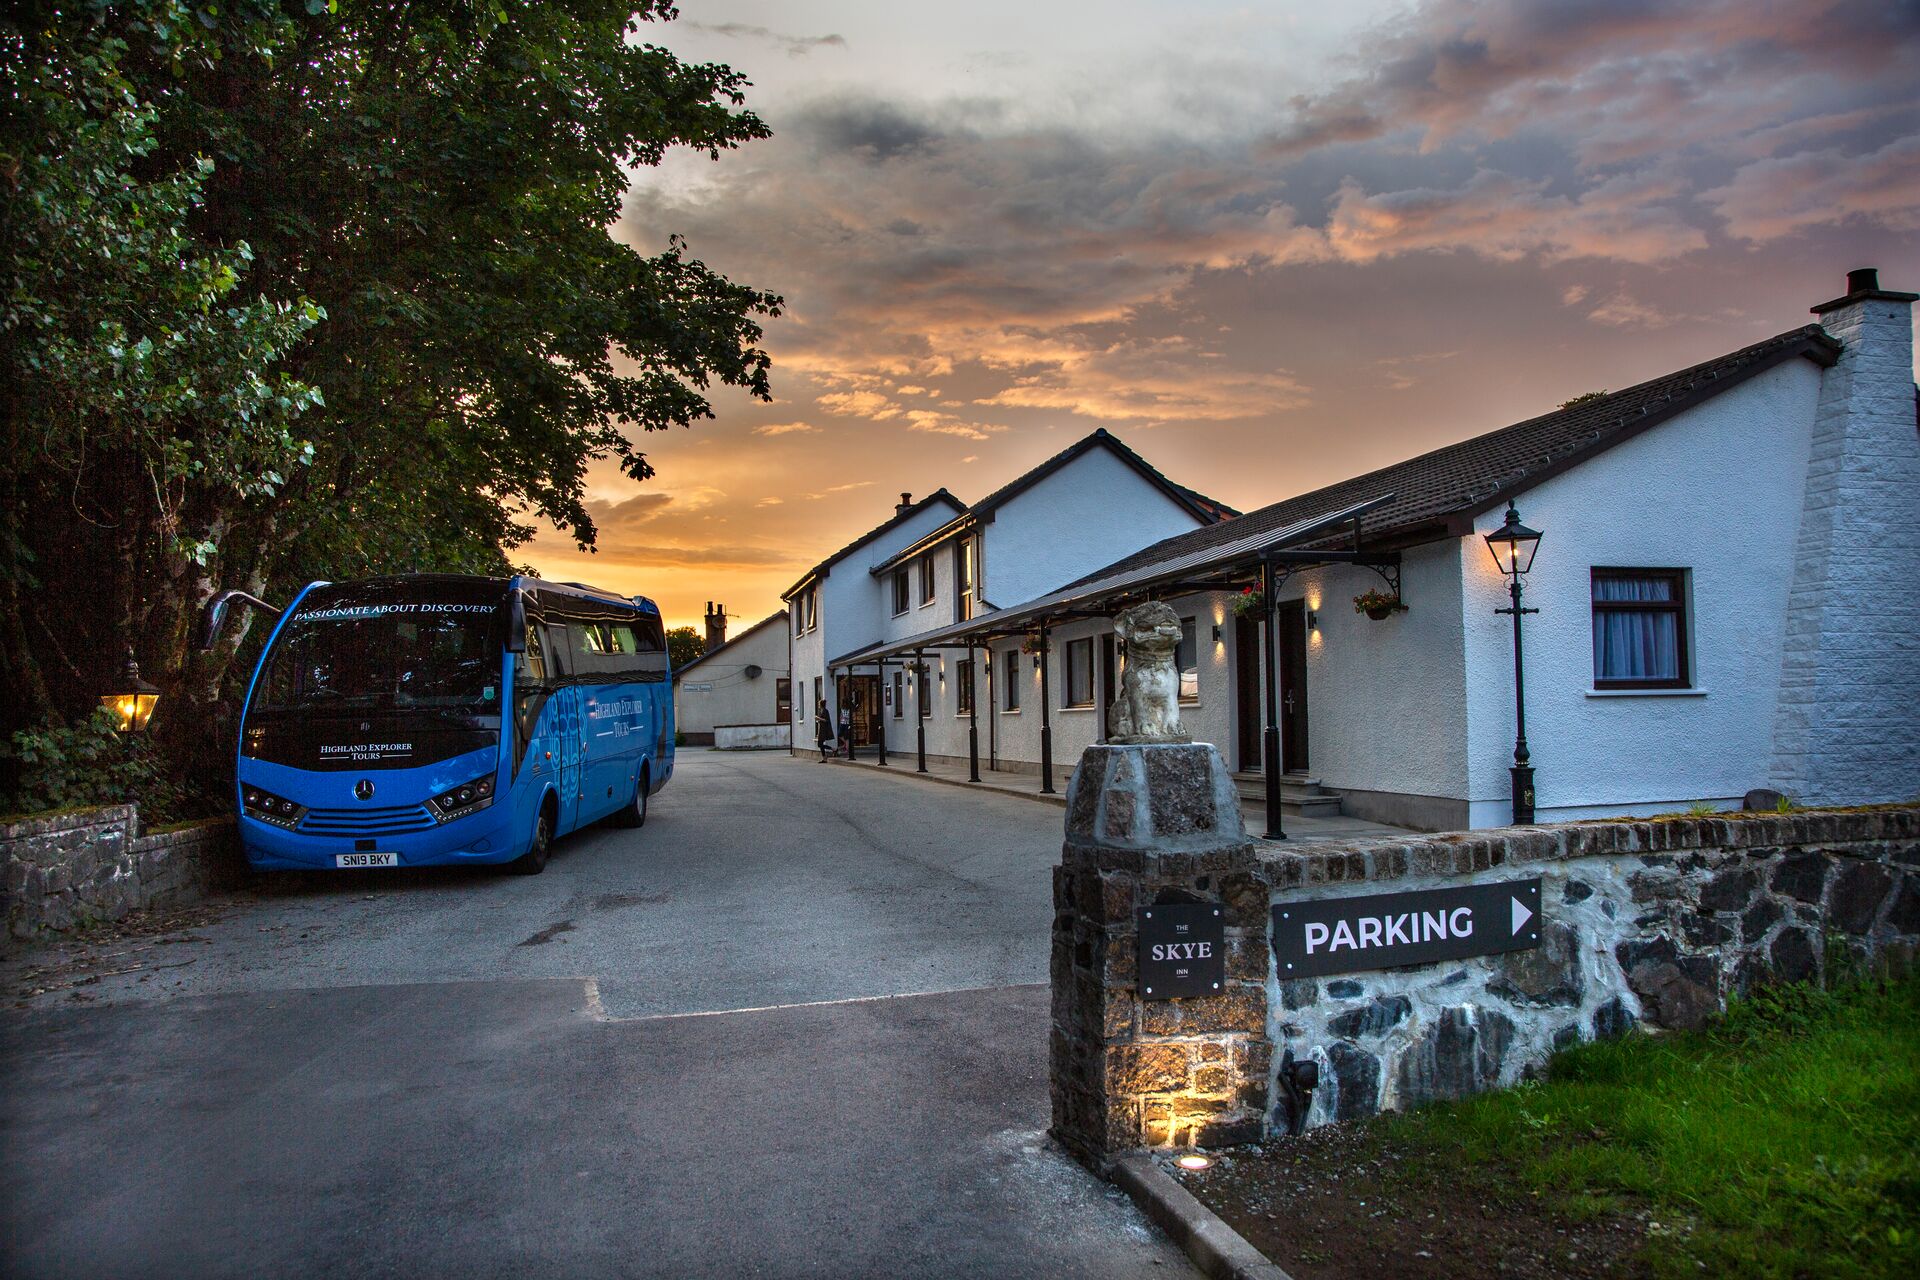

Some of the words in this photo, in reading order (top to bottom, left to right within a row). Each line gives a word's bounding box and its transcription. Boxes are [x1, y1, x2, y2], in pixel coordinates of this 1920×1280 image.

[294, 606, 369, 620] PASSIONATE
[371, 604, 418, 614] ABOUT
[420, 604, 497, 613] DISCOVERY
[594, 702, 621, 719] HIGHLAND
[621, 700, 643, 716] EXPLORER
[613, 721, 630, 738] TOURS
[320, 744, 367, 753] HIGHLAND
[368, 743, 413, 752] EXPLORER
[351, 752, 380, 760] TOURS
[343, 855, 367, 866] SN19
[369, 854, 390, 865] BKY
[1304, 906, 1473, 955] PARKING
[1152, 942, 1212, 961] SKYE
